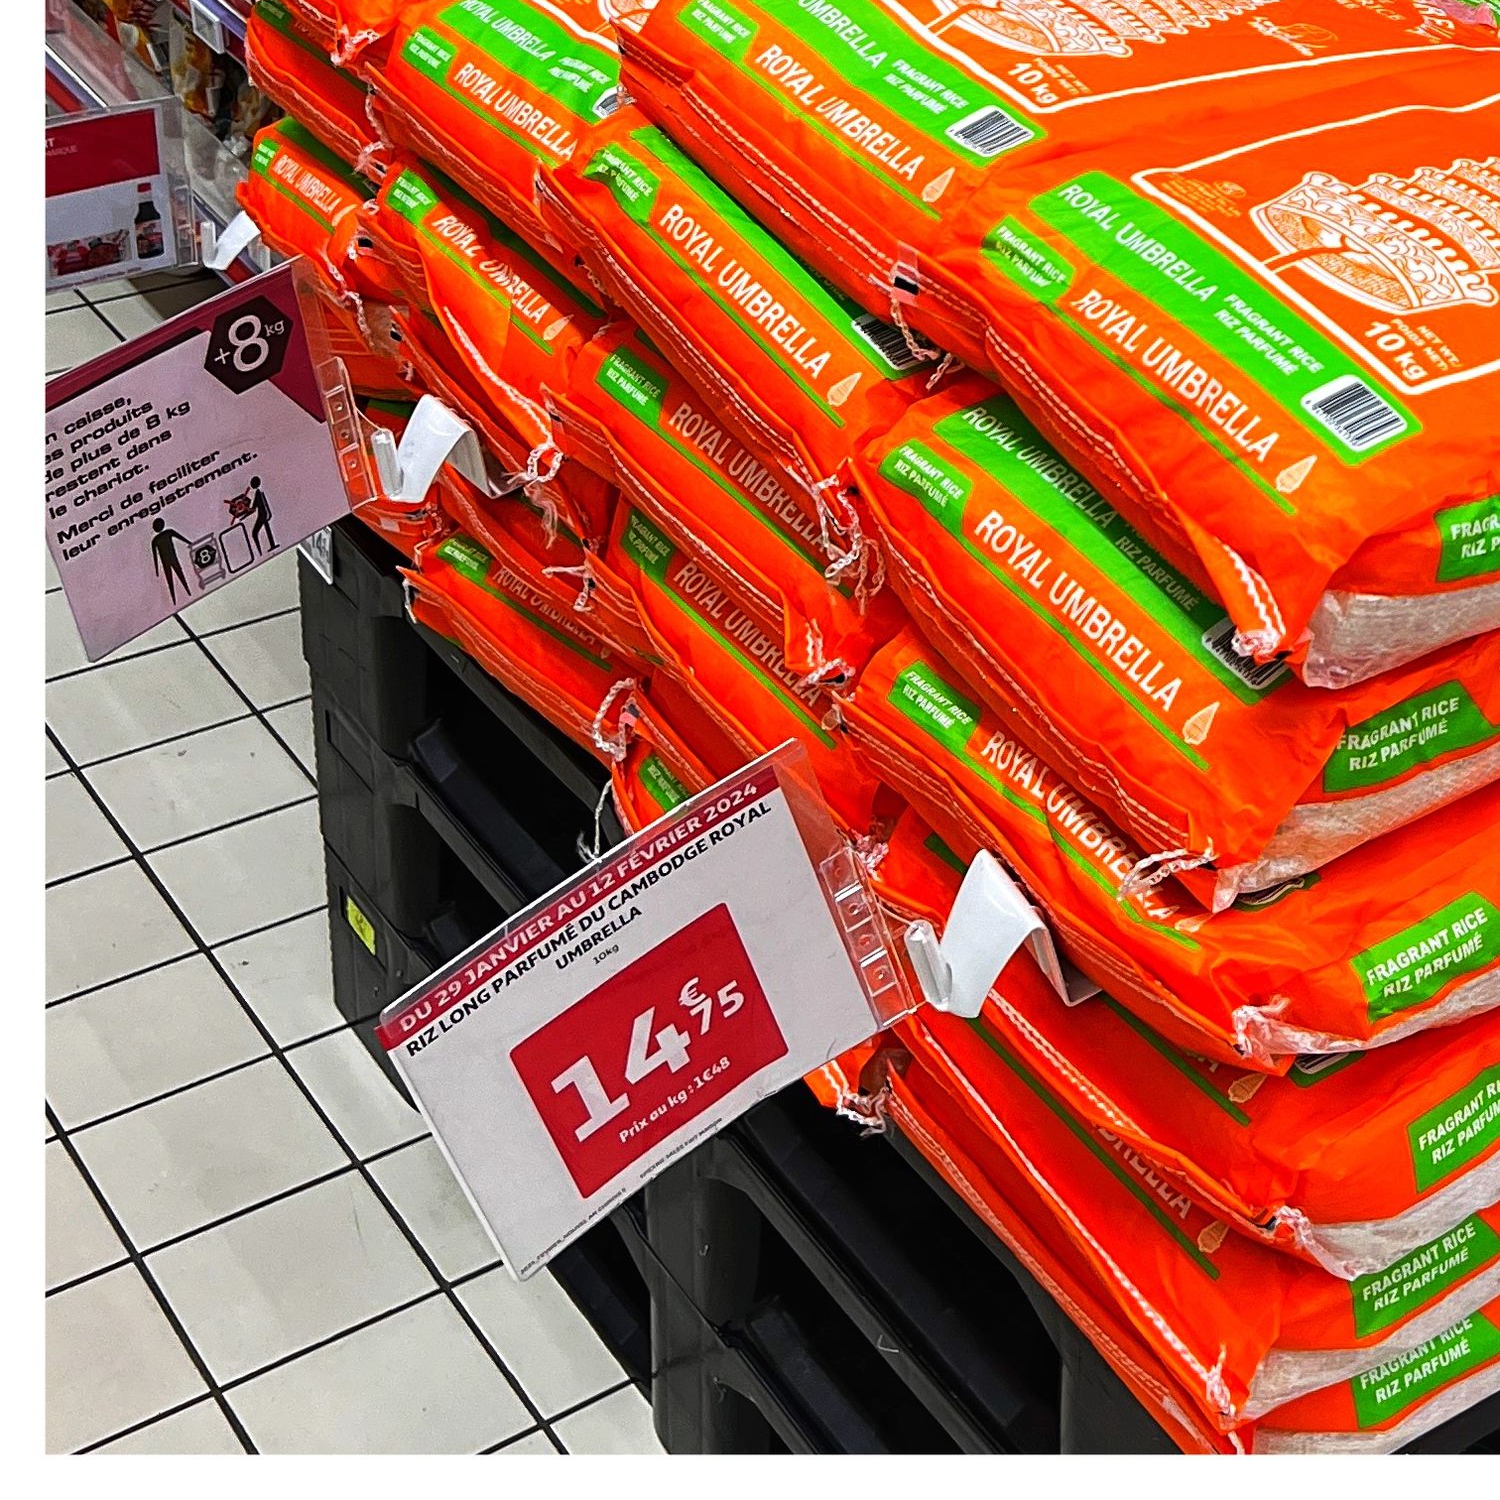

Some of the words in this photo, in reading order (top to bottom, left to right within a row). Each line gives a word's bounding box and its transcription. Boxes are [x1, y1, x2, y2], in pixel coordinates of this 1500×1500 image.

[453, 62, 505, 108] ROYAL
[498, 98, 579, 160] UMBRELLA
[755, 44, 815, 106] ROYAL
[816, 96, 926, 182] UMBRELLA
[1057, 183, 1116, 232] ROYAL
[1114, 228, 1219, 305] UMBRELLA
[264, 318, 286, 339] kg
[659, 204, 717, 273] ROYAL
[718, 258, 833, 381] UMBRELLA
[1213, 309, 1241, 334] RIZ
[1239, 328, 1300, 378] PARFUMÉ
[1223, 293, 1290, 350] FRAGRANT
[1290, 345, 1324, 374] RICE
[1363, 320, 1406, 355] 10
[1397, 352, 1428, 382] kg
[64, 396, 132, 435] caisse,
[1071, 289, 1142, 354] ROYAL
[1142, 335, 1280, 463] UMBRELLA
[45, 458, 120, 502] restent
[126, 429, 172, 460] dans
[70, 401, 153, 454] produits
[70, 443, 112, 473] plus
[118, 427, 141, 446] de
[146, 414, 160, 430] 8
[166, 401, 191, 419] kg
[48, 505, 67, 520] le
[73, 464, 150, 508] chariot.
[57, 505, 114, 545] Merci
[120, 491, 143, 510] de
[148, 451, 220, 494] faciliter
[63, 533, 100, 561] leur
[107, 452, 258, 537] enregistrement.
[1460, 534, 1490, 560] RIZ
[974, 509, 1053, 592] ROYAL
[1048, 571, 1182, 713] UMBRELLA
[399, 1003, 433, 1032] DU
[433, 981, 465, 1008] 29
[465, 915, 554, 995] JANVIER
[555, 890, 588, 921] AU
[588, 872, 616, 899] 12
[615, 818, 703, 892] FÉVRIER
[702, 782, 759, 826] 2024
[405, 1028, 439, 1058] RIZ
[438, 989, 492, 1036] LONG
[492, 924, 577, 996] PARFUMÉ
[576, 904, 607, 935] DU
[606, 835, 708, 914] CAMBODGE
[708, 800, 773, 851] ROYAL
[554, 905, 644, 971] UMBRELLA
[592, 943, 620, 965] 10kg
[618, 1115, 649, 1144] Prix
[648, 1100, 669, 1125] au
[669, 1089, 689, 1112] kg
[693, 1056, 731, 1092] 1€48
